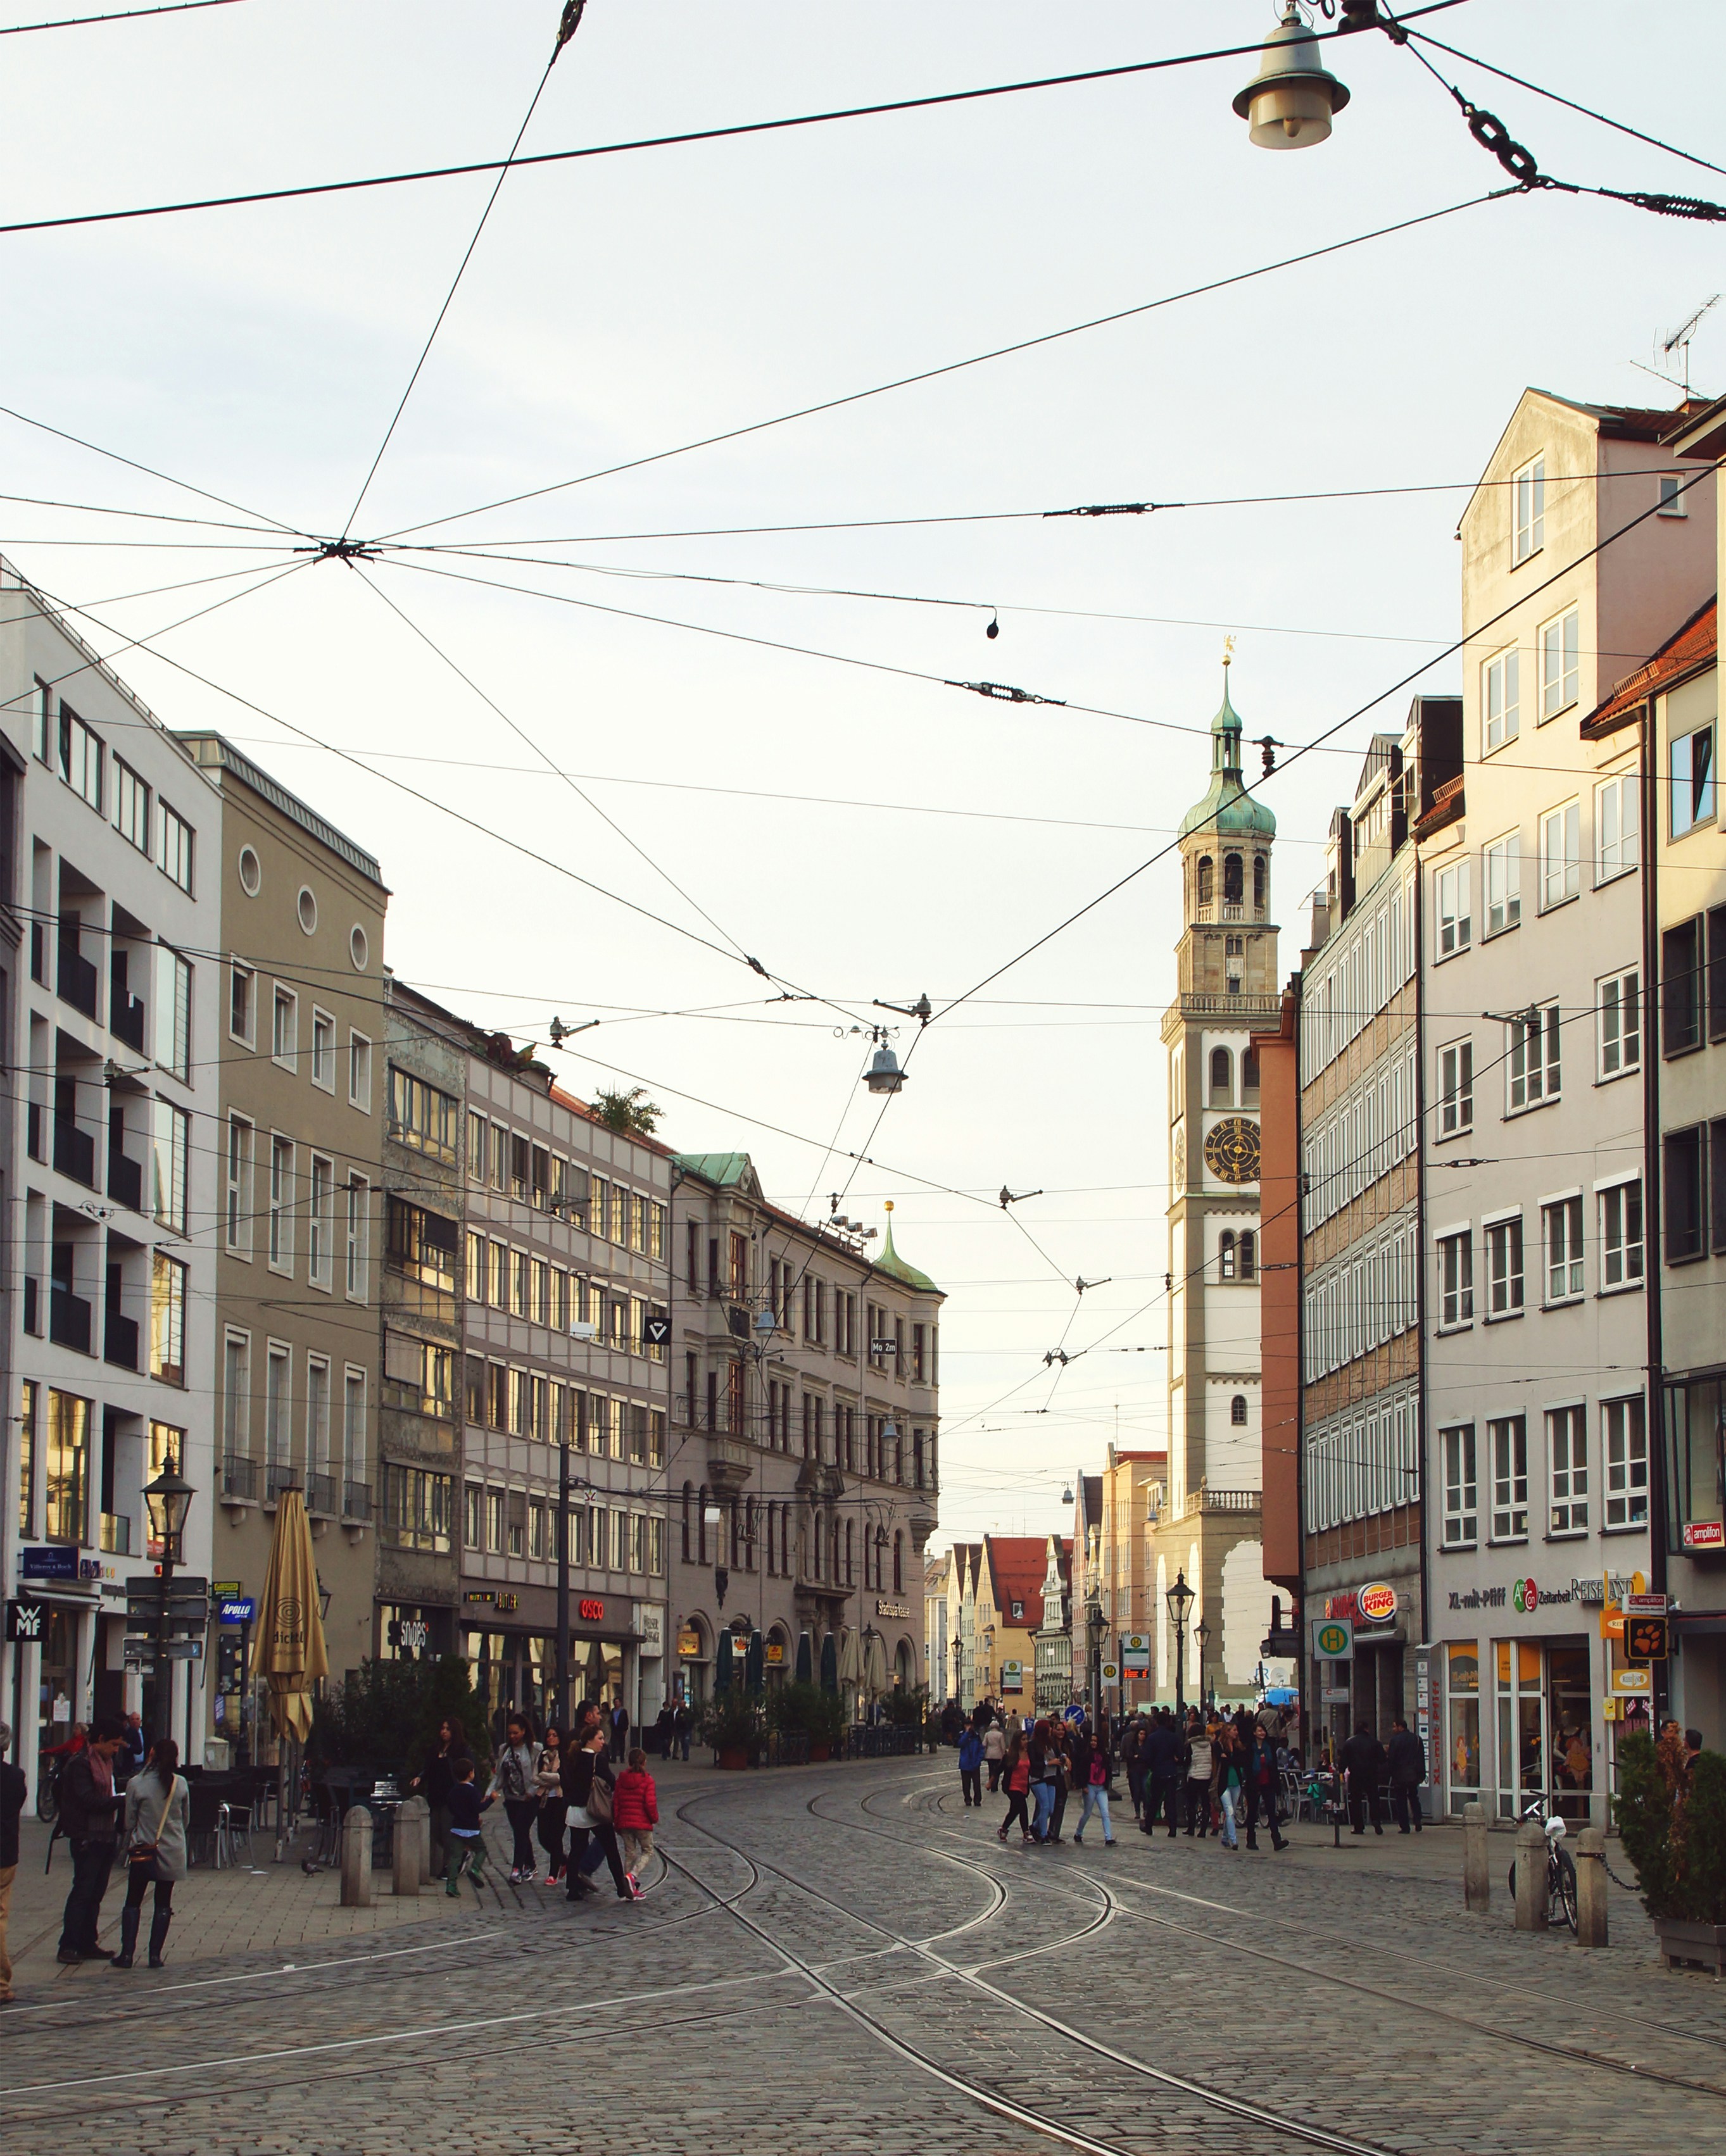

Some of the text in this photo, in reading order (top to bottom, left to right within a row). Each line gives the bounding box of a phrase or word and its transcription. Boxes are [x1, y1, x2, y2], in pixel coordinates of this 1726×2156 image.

[873, 1343, 895, 1351] Mo 2m
[1694, 1526, 1720, 1541] amplifon
[1363, 1591, 1392, 1603] BURGER
[1364, 1597, 1394, 1613] KING
[1448, 1586, 1506, 1610] XL-mit-Pfiff
[1539, 1589, 1571, 1605] Zeitarbeit
[222, 1604, 251, 1615] APOLLO
[581, 1599, 604, 1620] OSCO
[1326, 1631, 1340, 1648] H
